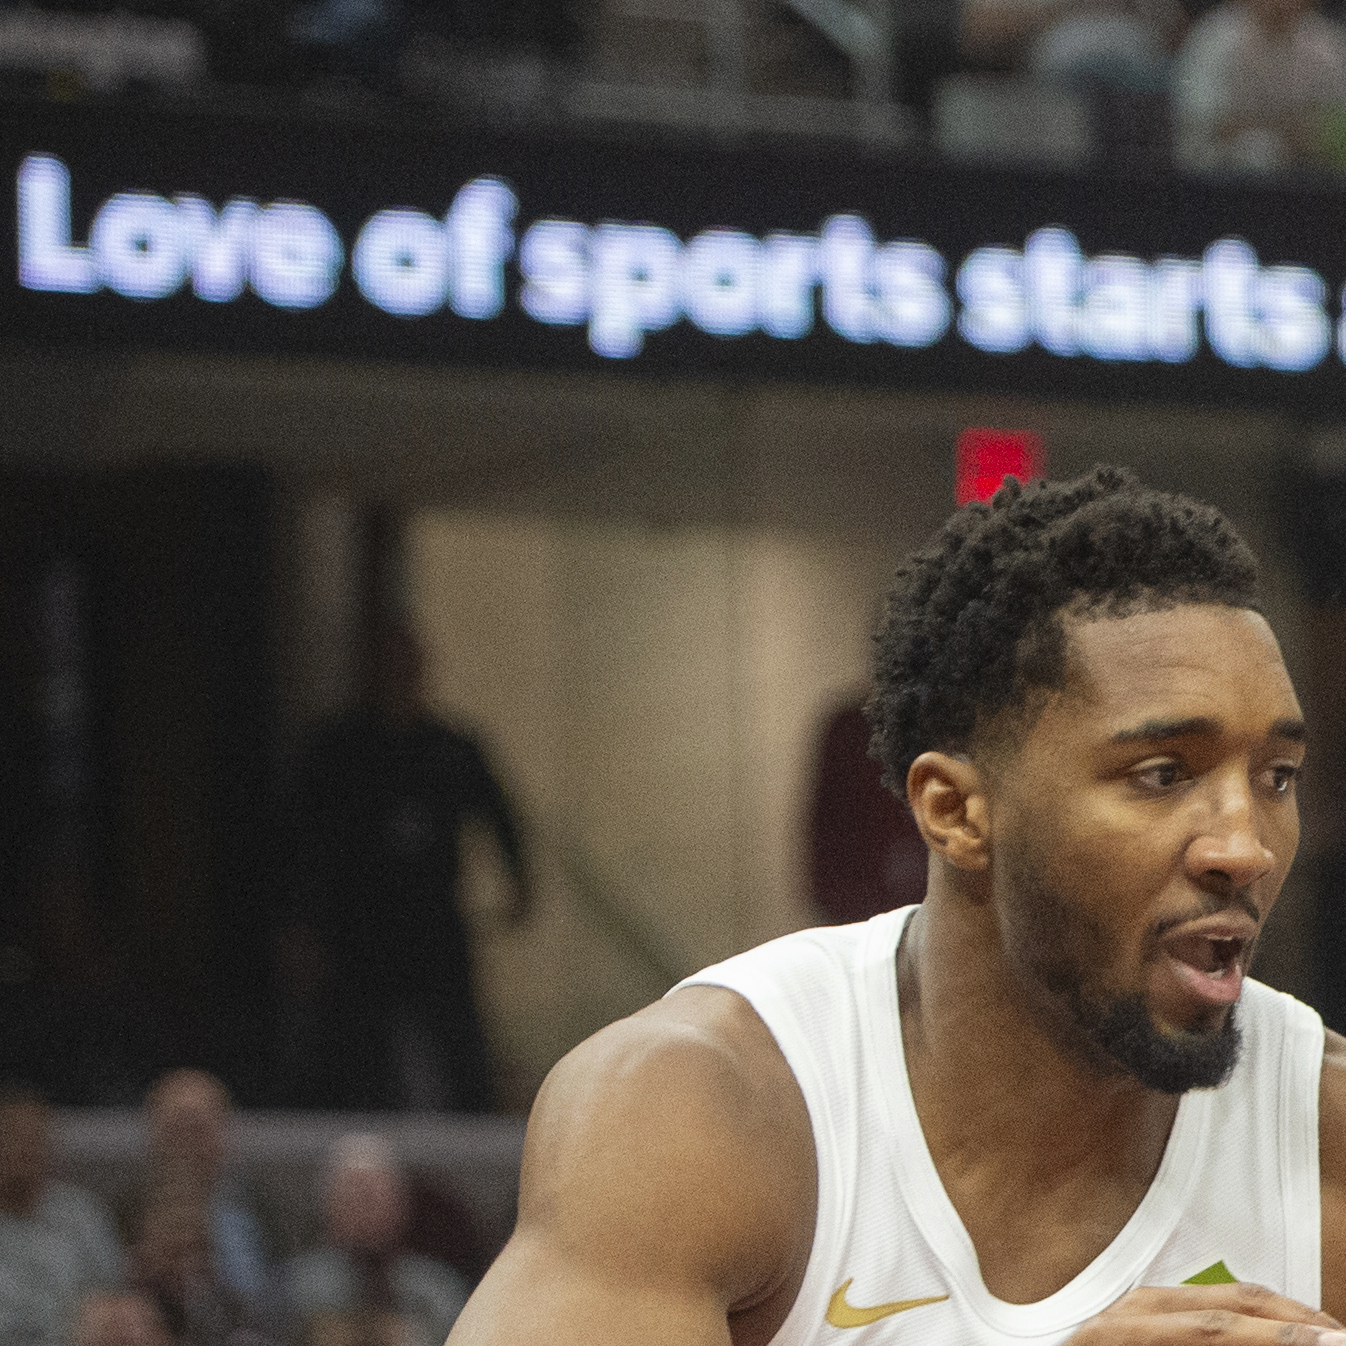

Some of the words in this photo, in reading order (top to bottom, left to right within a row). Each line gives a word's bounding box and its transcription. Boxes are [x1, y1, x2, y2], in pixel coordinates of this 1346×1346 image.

[16, 152, 344, 309] Love
[351, 175, 519, 320] of
[519, 211, 952, 360] sports
[956, 225, 1332, 372] starts
